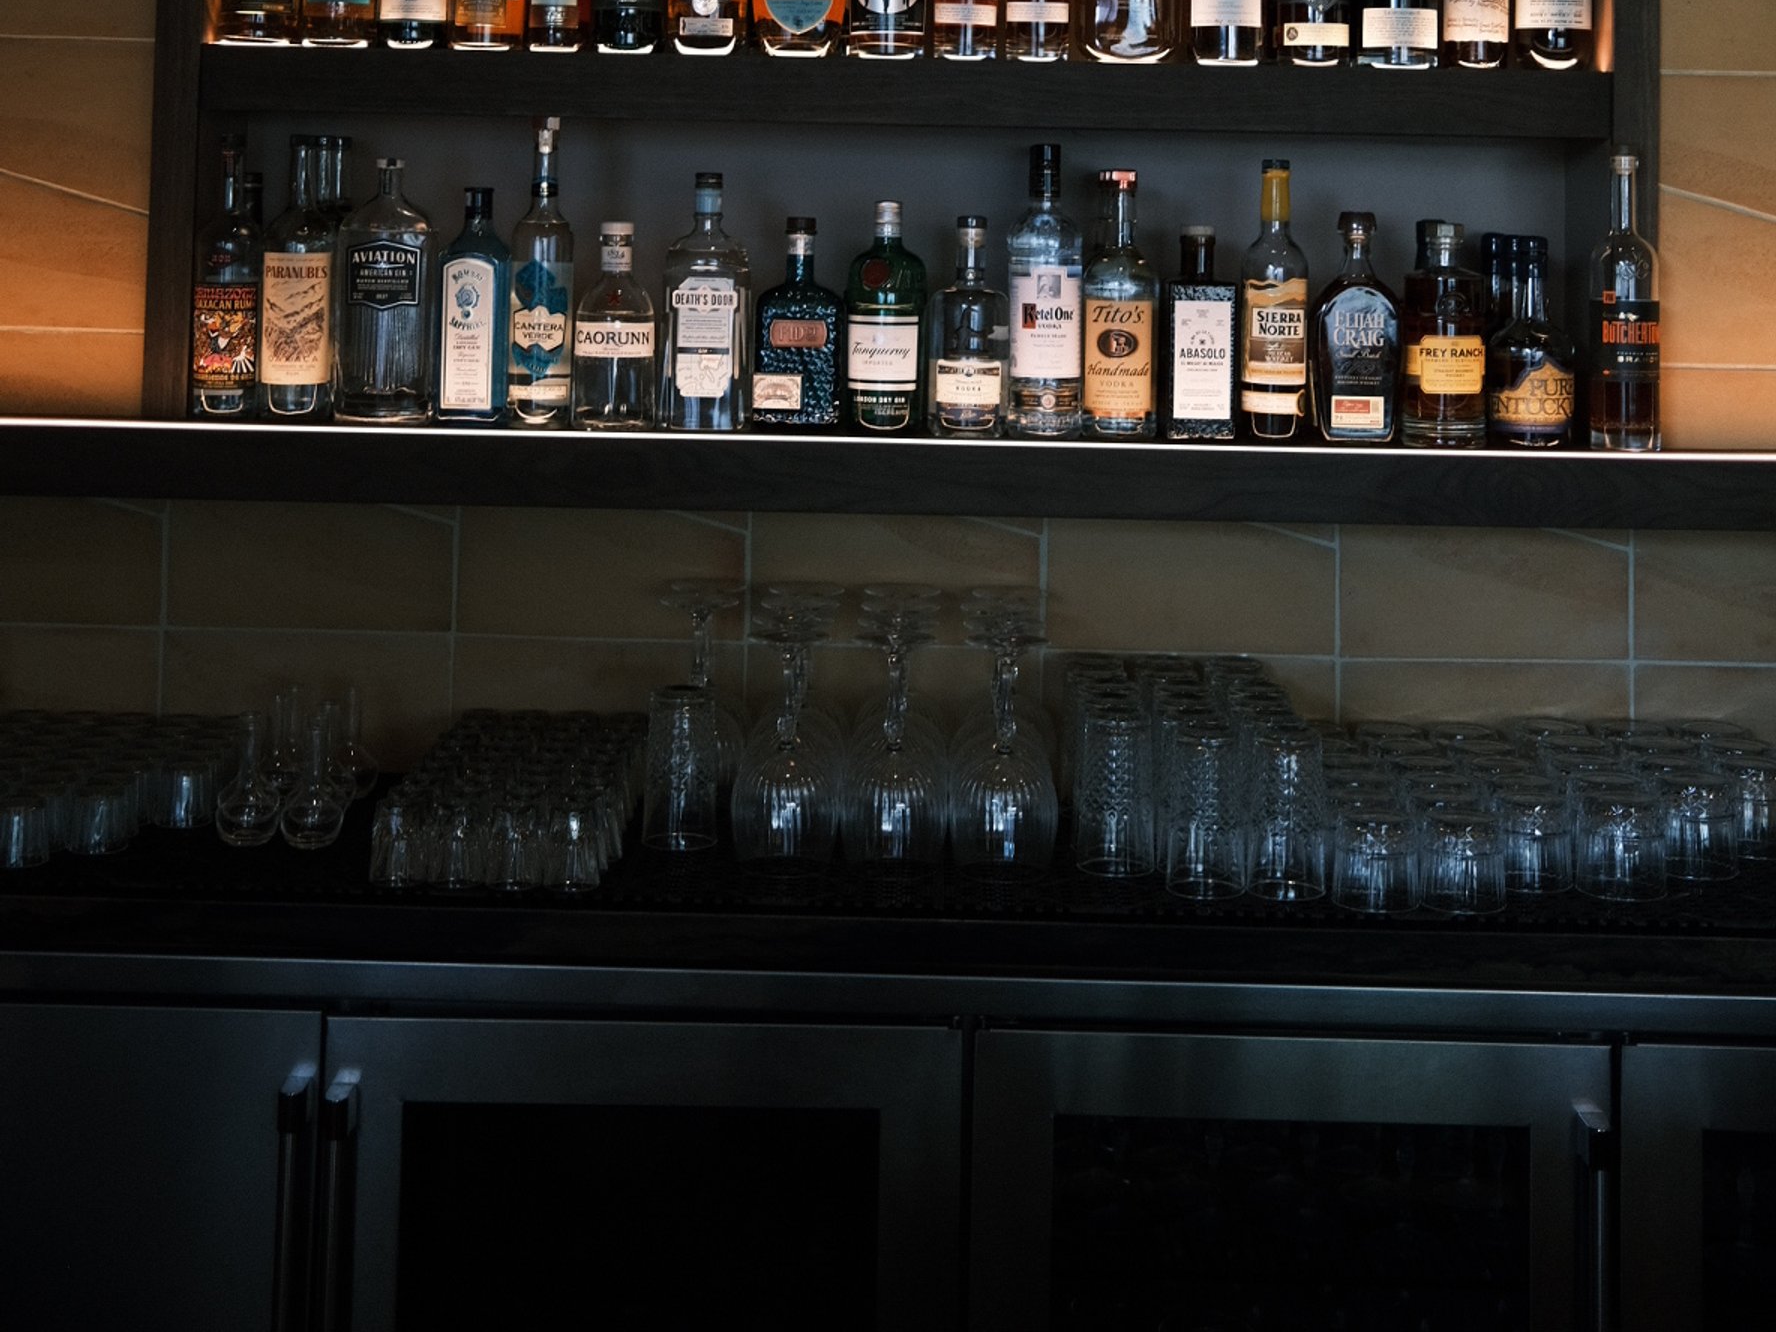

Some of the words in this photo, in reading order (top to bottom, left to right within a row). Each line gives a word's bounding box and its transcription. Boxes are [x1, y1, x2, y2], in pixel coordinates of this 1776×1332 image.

[352, 250, 416, 264] AVIATION
[265, 265, 328, 279] PARANUBES
[675, 293, 708, 305] DEATH'S
[711, 293, 734, 306] DOOR
[1023, 303, 1054, 325] Ketel
[1055, 306, 1074, 321] One
[1092, 304, 1145, 324] Tito's
[1257, 310, 1302, 324] SIERRA
[1334, 310, 1385, 330] ELIJAH
[515, 322, 564, 332] CANTERA
[1258, 323, 1300, 336] NORTE
[576, 330, 650, 347] CAORUNN
[1333, 328, 1385, 348] CRAIG
[852, 341, 911, 360] Tanqueray
[1179, 347, 1226, 359] ABASOLO
[1419, 348, 1447, 358] FREY
[1450, 348, 1483, 358] RANCH
[1087, 361, 1150, 377] Handmade
[1100, 380, 1135, 388] VODKA
